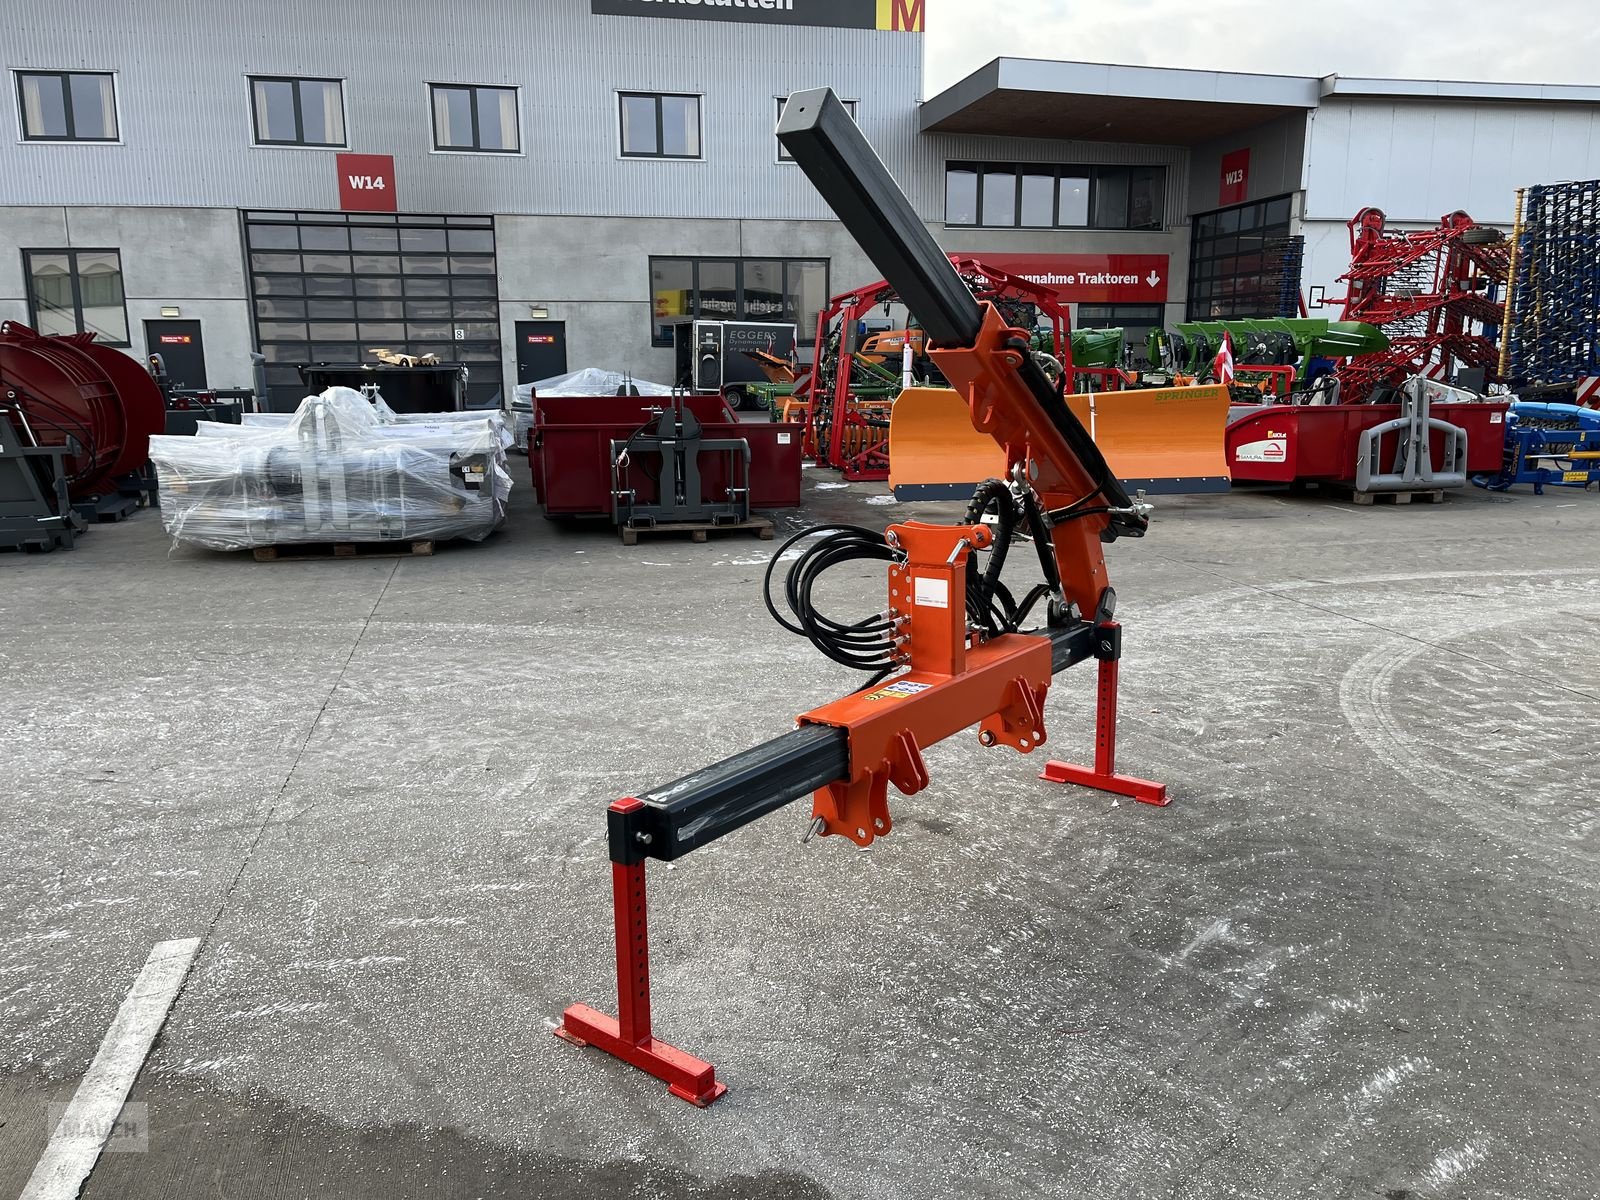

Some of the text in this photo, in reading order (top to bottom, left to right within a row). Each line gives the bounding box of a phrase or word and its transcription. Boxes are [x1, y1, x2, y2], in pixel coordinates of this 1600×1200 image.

[348, 175, 386, 190] W14
[1226, 169, 1243, 185] W13
[1077, 272, 1139, 284] Traktoren
[456, 330, 463, 339] 8
[729, 330, 777, 340] EGGERS
[1155, 388, 1219, 401] SPRINGER
